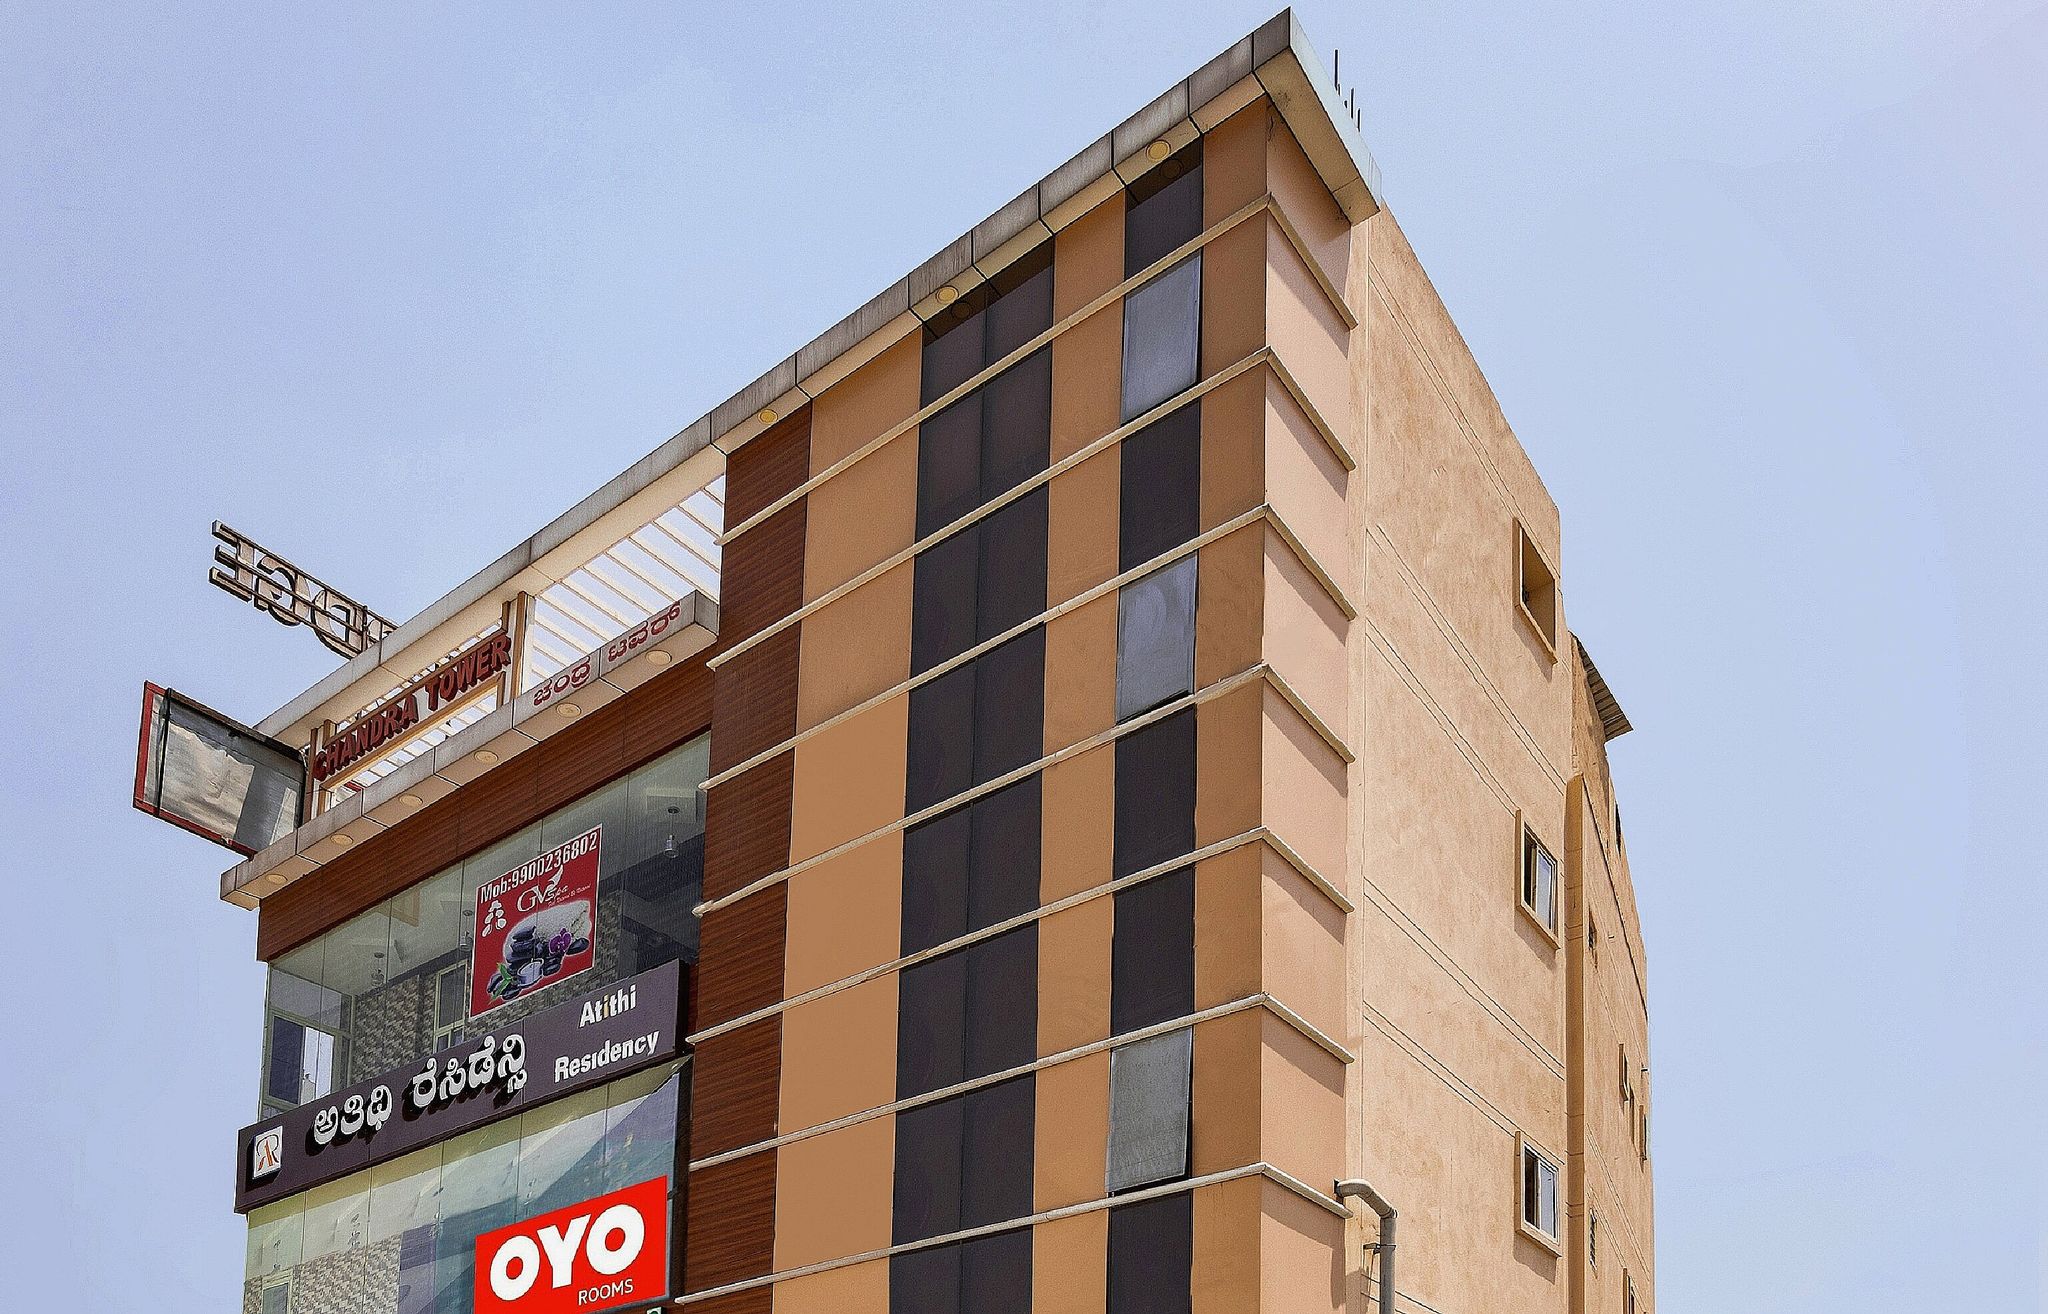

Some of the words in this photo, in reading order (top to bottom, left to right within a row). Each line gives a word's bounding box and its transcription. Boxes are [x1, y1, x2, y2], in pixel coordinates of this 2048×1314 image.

[533, 655, 591, 706] ಚಂದ್ರ
[608, 600, 681, 662] ಟವರ್
[312, 693, 419, 782] CHANDRA
[425, 634, 512, 711] TOWER
[480, 832, 598, 904] Mob:9900236802
[578, 984, 637, 1028] Atithi
[314, 1085, 392, 1145] ಅತಿಥಿ
[412, 1034, 528, 1108] ರೆಸಿಡೆನ್ಸಿ
[554, 1030, 660, 1083] Residency
[489, 1203, 645, 1301] OYO
[578, 1278, 634, 1306] ROOMS
